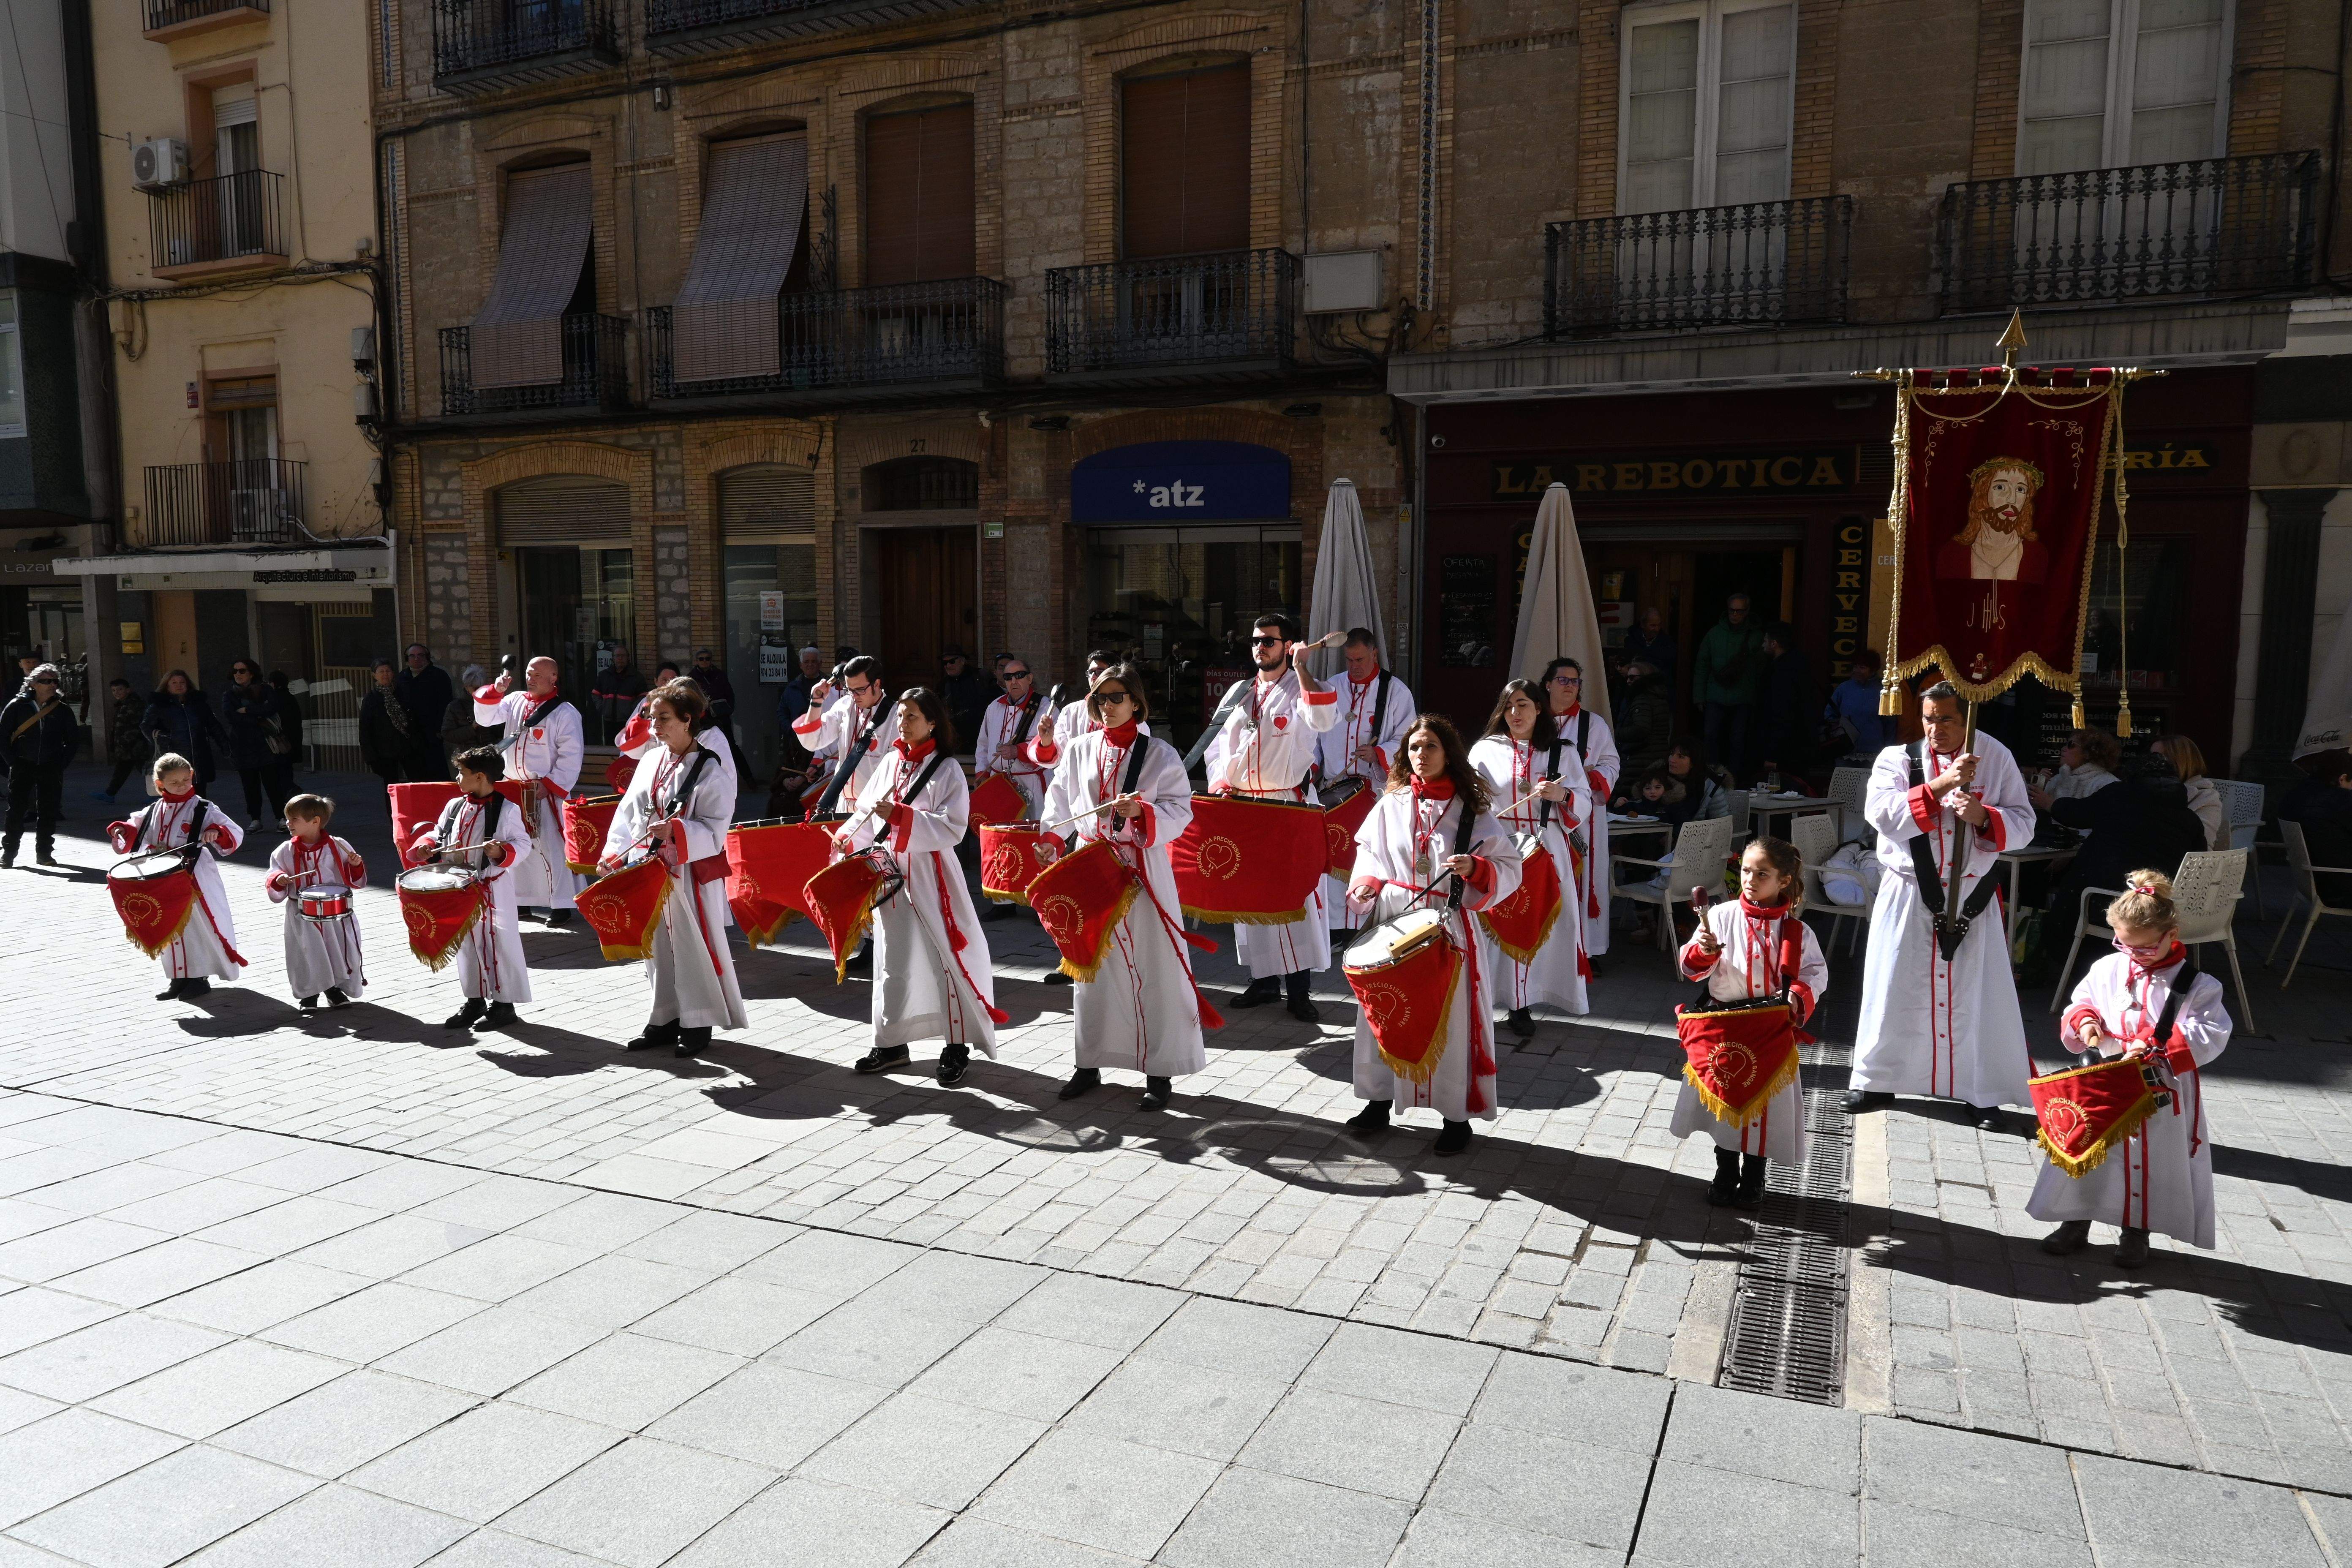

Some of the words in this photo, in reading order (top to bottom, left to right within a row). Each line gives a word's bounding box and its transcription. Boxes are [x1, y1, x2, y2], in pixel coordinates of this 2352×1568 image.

[910, 439, 926, 452] 27
[1495, 466, 1553, 493] LA
[1575, 456, 1845, 491] REBOTICA
[1444, 557, 1485, 568] OFERTA
[254, 571, 301, 584] Arquitectura
[302, 572, 308, 581] e
[308, 569, 357, 582] Interiorismo
[1831, 526, 1863, 677] CERVECE
[598, 658, 603, 667] SE
[760, 654, 765, 664] SE
[767, 654, 786, 664] ALQUILA
[769, 668, 774, 677] 23
[775, 668, 780, 677] 84
[782, 668, 786, 677] 19
[1206, 683, 1224, 697] 10
[1199, 843, 1206, 851] DE
[1327, 824, 1348, 834] ECIOSISIMA
[1342, 834, 1350, 852] SANGRE
[1002, 843, 1024, 864] PRECIOSISIMA
[1213, 836, 1241, 861] PRECIOSISIMA
[1011, 866, 1024, 882] SANGRE
[1197, 852, 1210, 877] COFRADIA
[1222, 863, 1240, 880] SANGRE
[130, 893, 162, 909] PRECIOSISIMA
[150, 910, 163, 927] SANGRE
[1042, 907, 1047, 915] LA
[1043, 895, 1078, 909] PRECIOSISIMA
[1493, 907, 1512, 919] COFRAD
[1520, 896, 1530, 915] SANGRE
[407, 903, 436, 924] PRECIOSISIMA
[1075, 909, 1083, 935] SANGRE
[1397, 1007, 1411, 1027] SANGRE
[1707, 1053, 1714, 1062] DE
[1711, 1045, 1720, 1054] LA
[1718, 1042, 1757, 1064] PRECIOSISIMA
[1707, 1063, 1729, 1089] COFRADIA
[1742, 1065, 1757, 1088] SANGRE
[2049, 1097, 2090, 1122] PRECIOSISIMA
[2077, 1123, 2092, 1147] SANGRE
